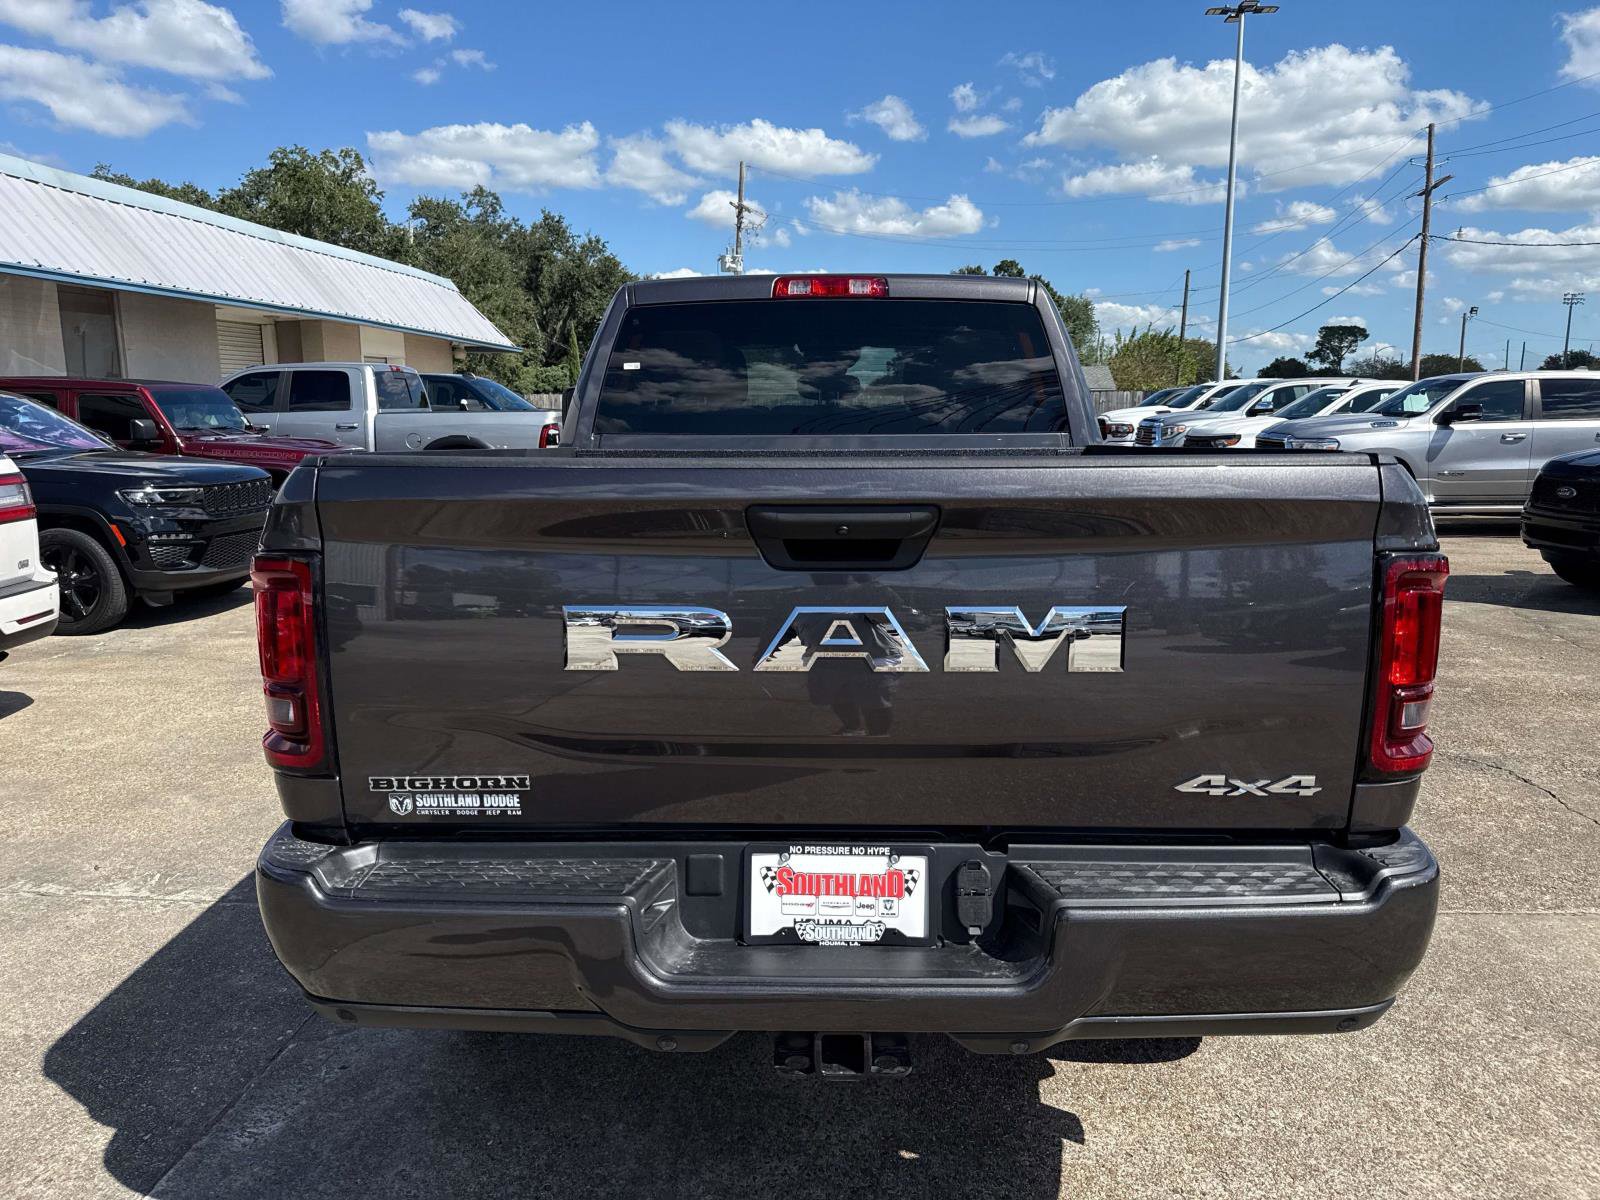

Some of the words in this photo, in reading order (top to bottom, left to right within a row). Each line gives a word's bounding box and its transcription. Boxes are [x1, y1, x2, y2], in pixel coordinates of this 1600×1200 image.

[562, 605, 1126, 673] RAM
[368, 775, 530, 791] BIGHORN
[415, 794, 480, 807] SOUTHLAND
[483, 794, 520, 807] DODGE
[789, 845, 802, 854] NO
[804, 846, 850, 855] PRESSURE
[852, 846, 865, 855] NO
[867, 847, 890, 856] HYPE
[776, 866, 905, 899] SOUTHLAND
[856, 902, 875, 910] Jeep
[805, 923, 876, 941] SOUTHLAND
